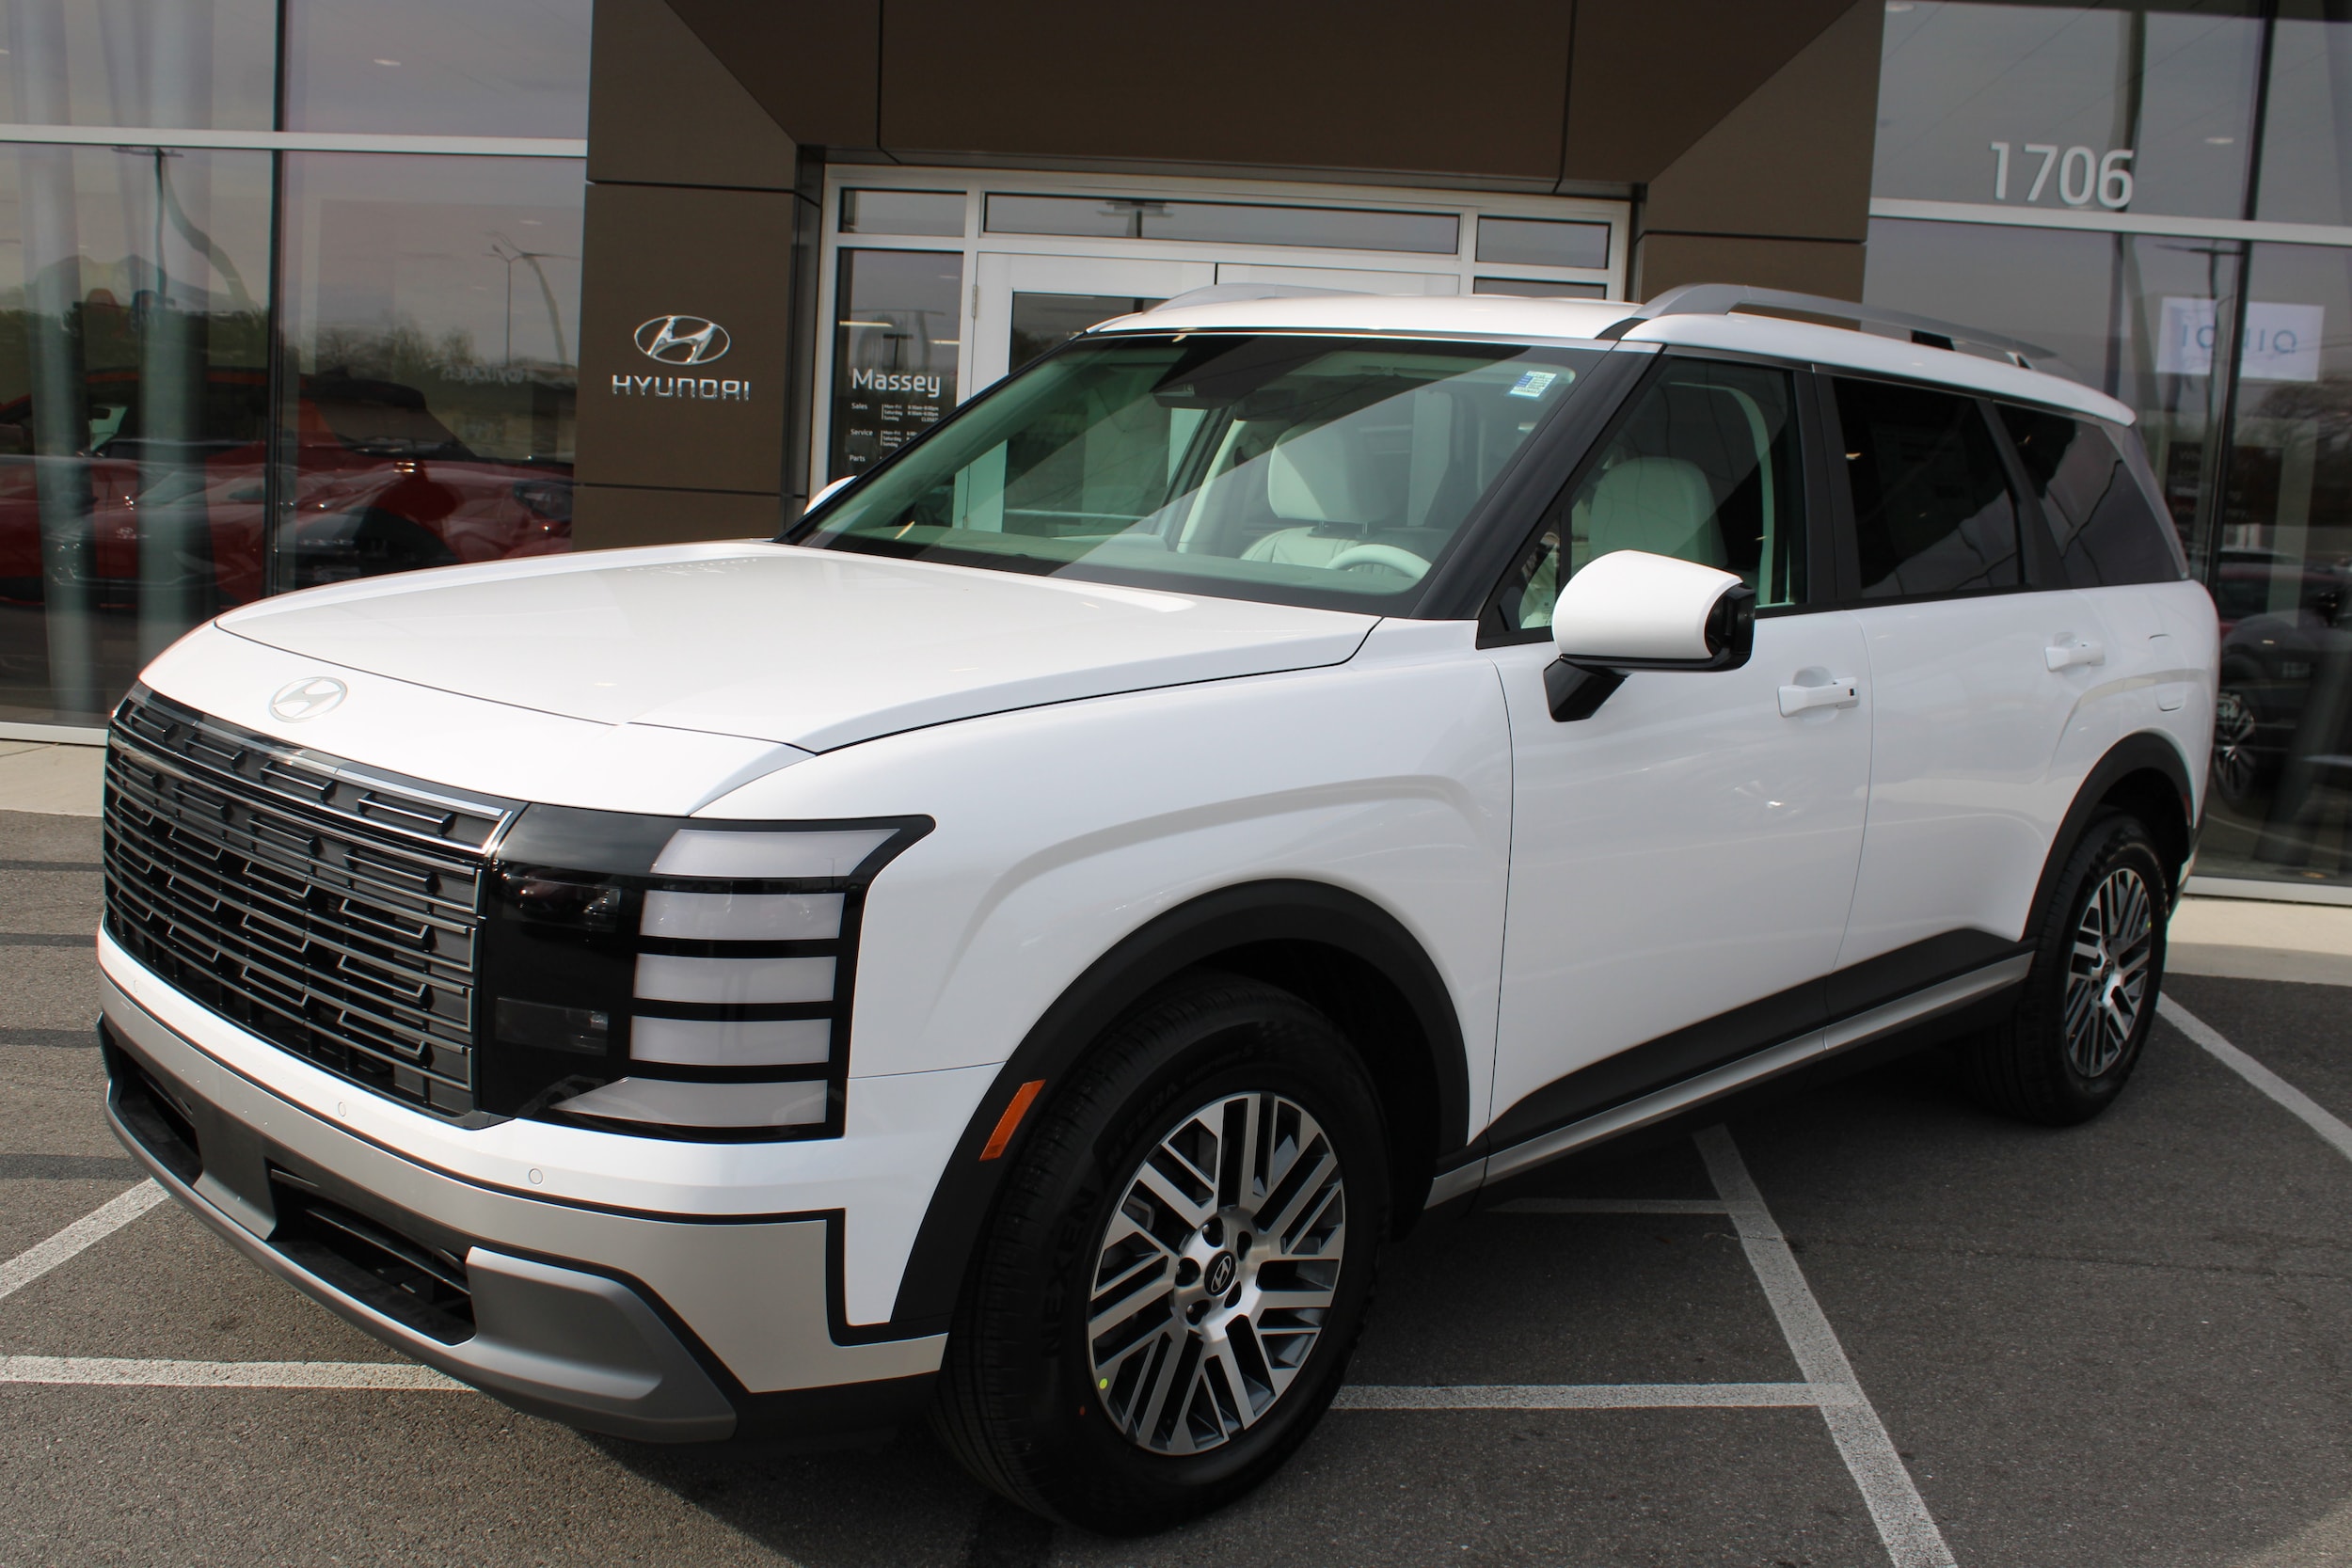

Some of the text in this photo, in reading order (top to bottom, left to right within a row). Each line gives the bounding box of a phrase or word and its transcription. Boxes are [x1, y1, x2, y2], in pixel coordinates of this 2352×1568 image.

[1990, 141, 2134, 209] 1706
[612, 374, 751, 401] HYUNDAI
[852, 368, 940, 398] Massey
[1041, 1186, 1098, 1358] NEXEN
